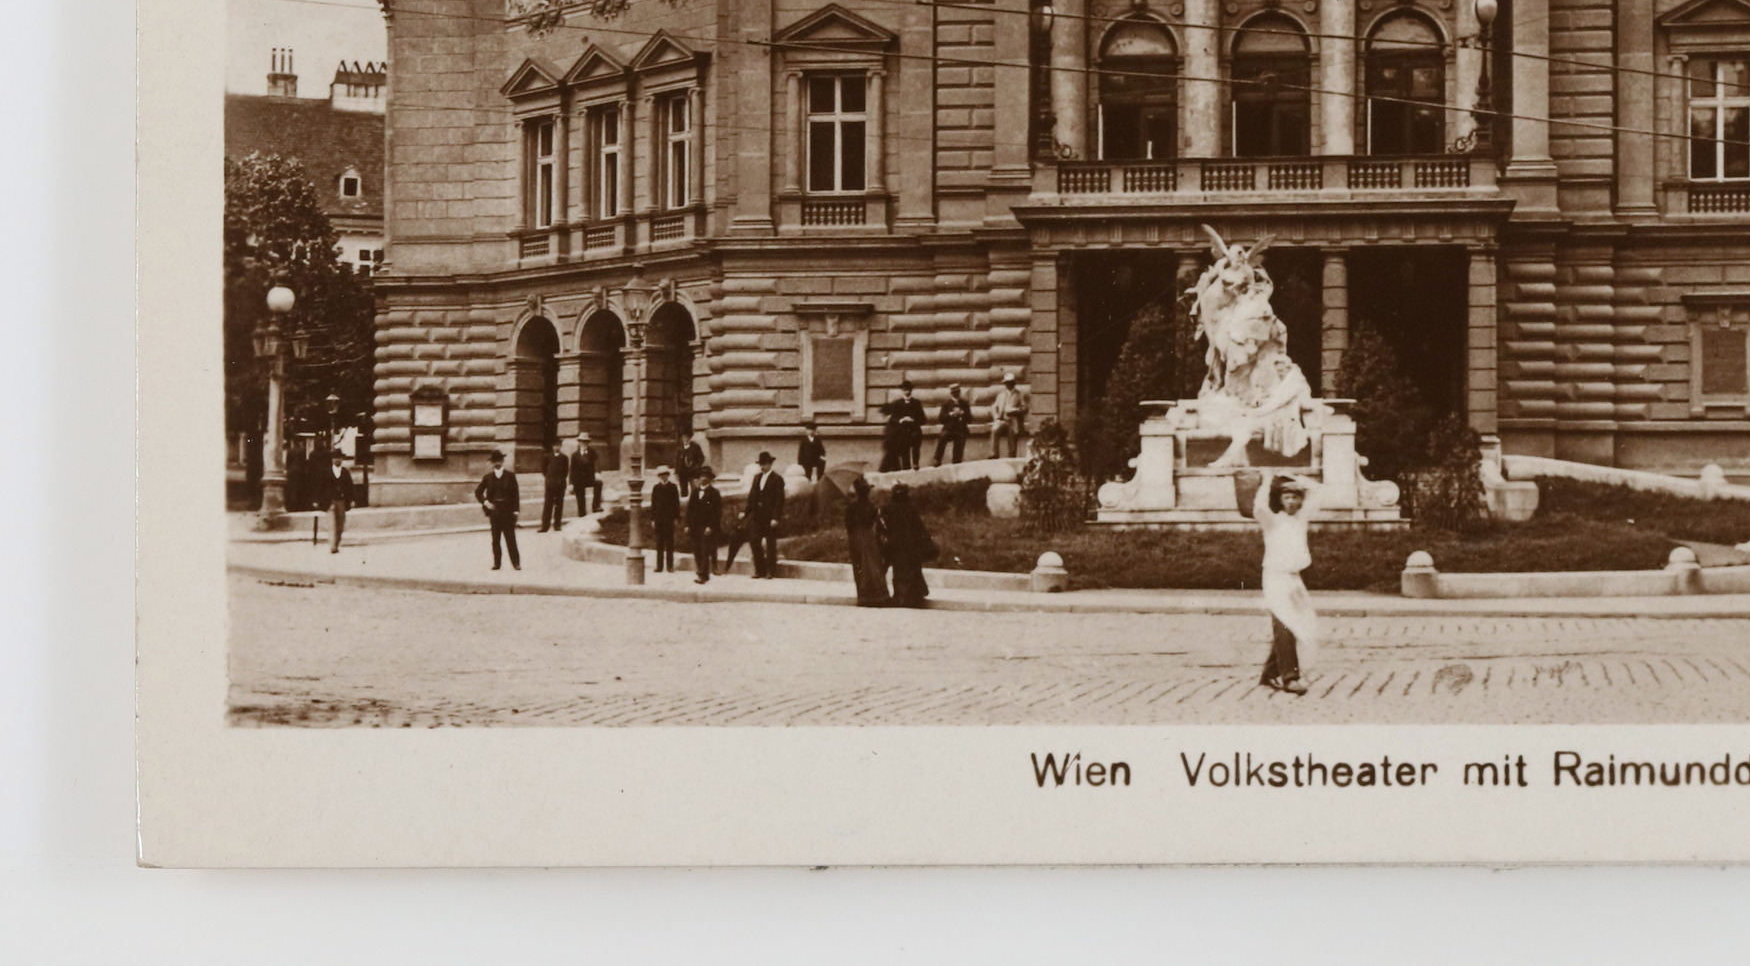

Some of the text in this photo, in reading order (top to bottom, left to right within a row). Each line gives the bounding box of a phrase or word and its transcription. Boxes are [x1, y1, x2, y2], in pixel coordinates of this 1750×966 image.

[1030, 752, 1131, 788] Wien
[1180, 751, 1438, 788] Volkstheater
[1463, 754, 1528, 788] mit
